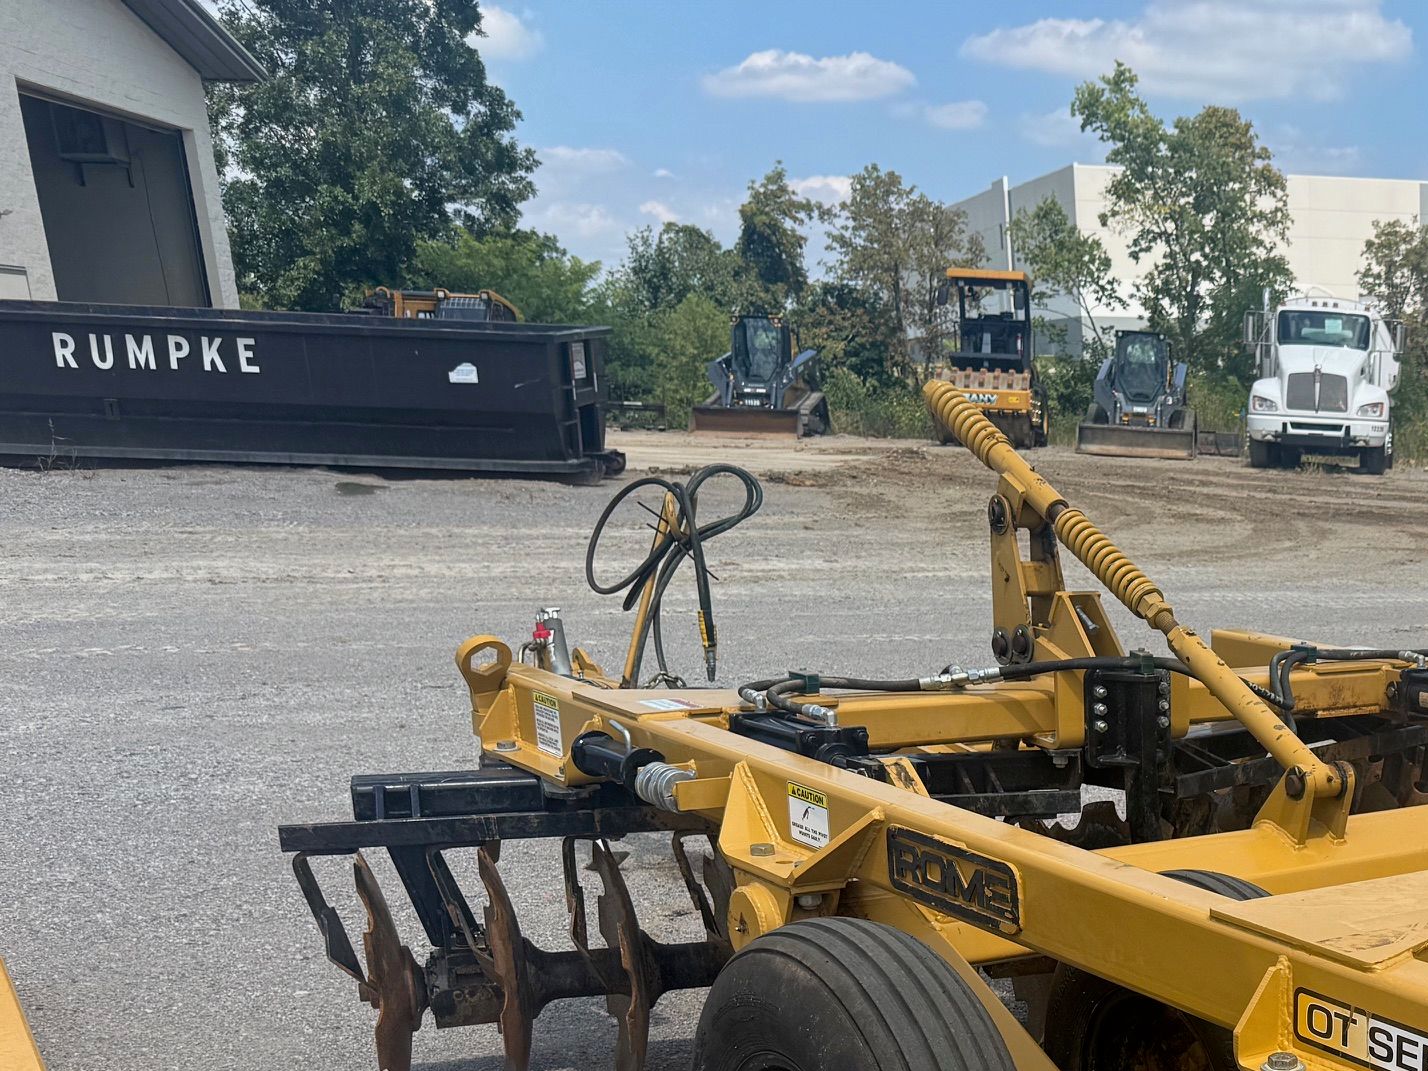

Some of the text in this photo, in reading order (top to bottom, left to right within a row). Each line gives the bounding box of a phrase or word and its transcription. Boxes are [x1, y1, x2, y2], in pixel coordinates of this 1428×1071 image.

[51, 331, 261, 374] RUMPKE
[797, 788, 824, 804] CAUTION
[894, 844, 1013, 922] ROME
[1306, 1003, 1358, 1048] OT
